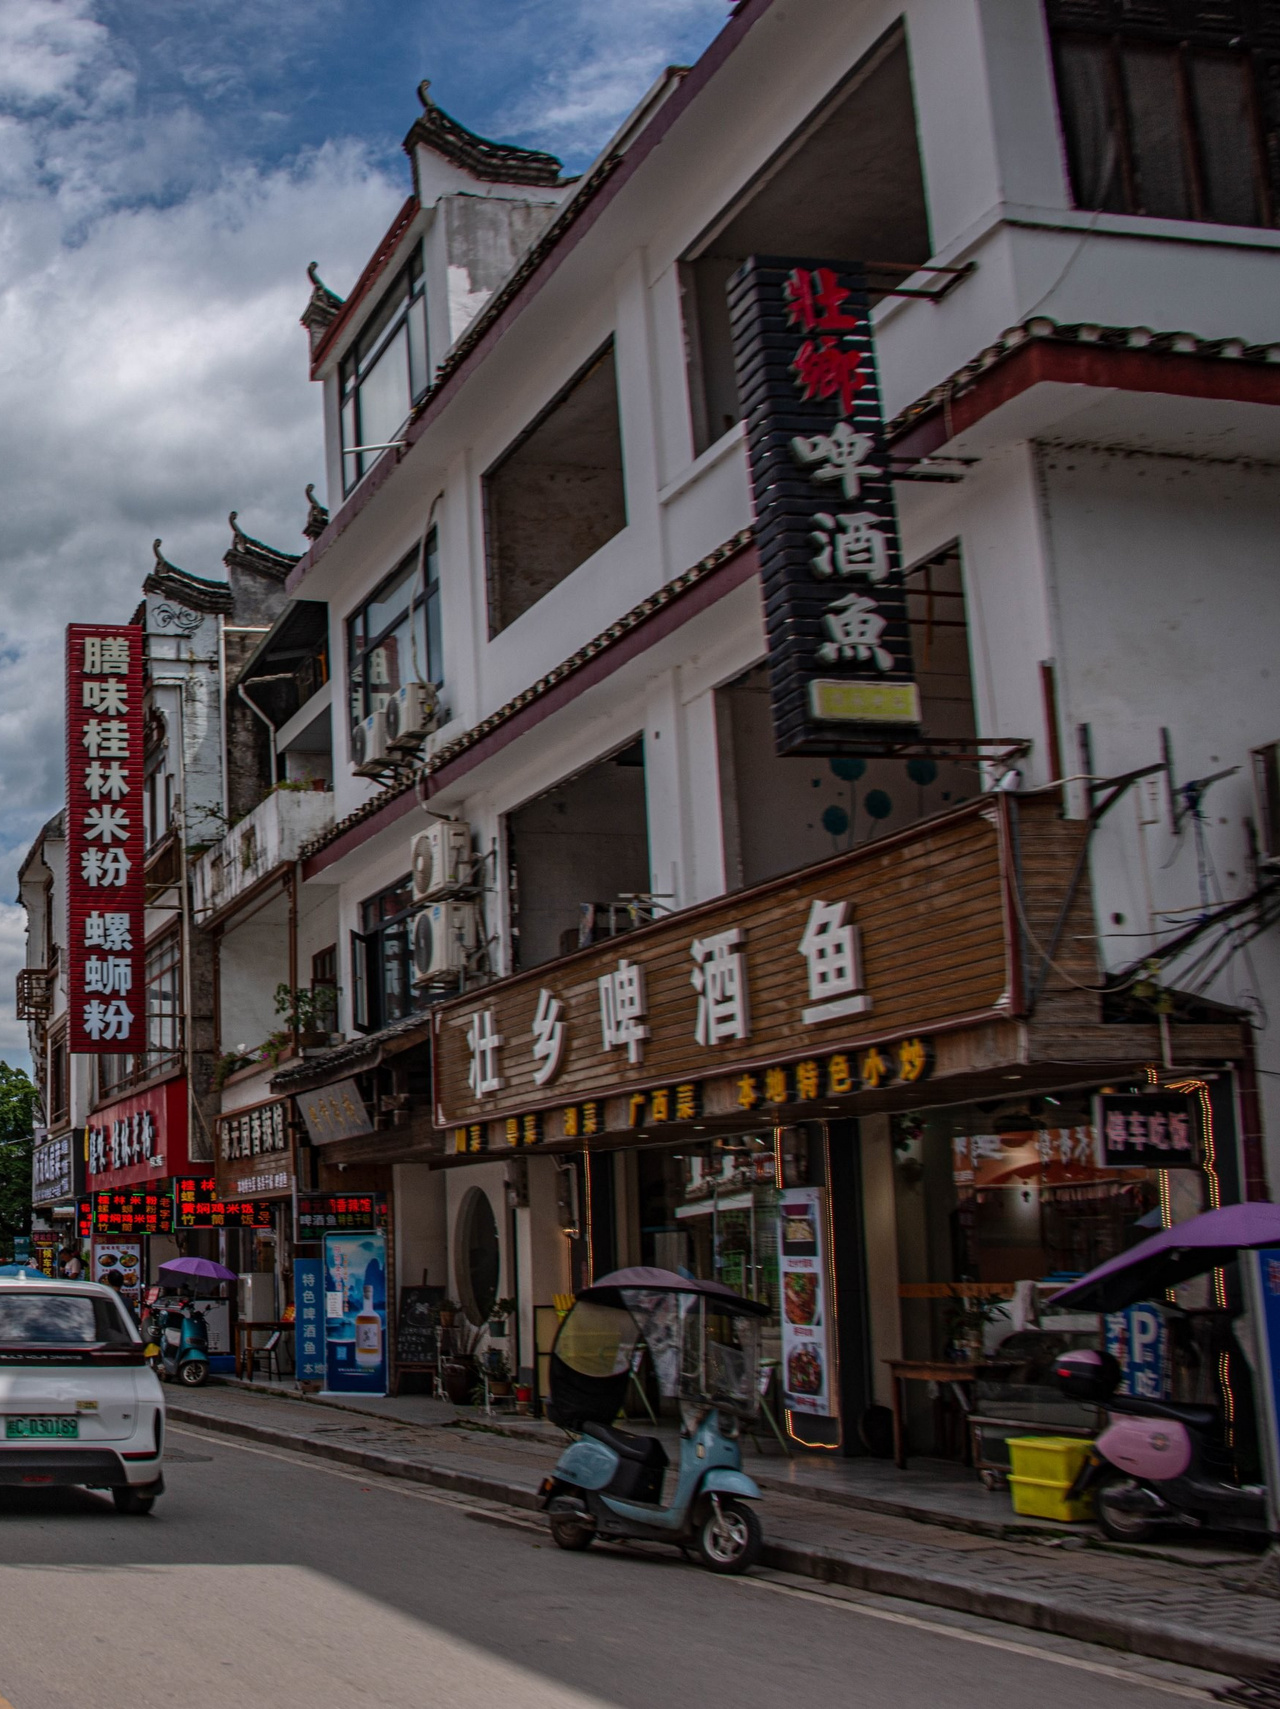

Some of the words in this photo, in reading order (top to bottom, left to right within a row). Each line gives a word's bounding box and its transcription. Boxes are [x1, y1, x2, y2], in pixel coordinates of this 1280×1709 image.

[83, 910, 134, 1041] 螺蛳粉
[467, 899, 873, 1099] 壮乡啤酒鱼
[629, 1084, 696, 1127] 广西菜
[736, 1038, 926, 1112] 本地特色小炒
[181, 1179, 216, 1192] 桂林
[181, 1202, 255, 1215] 黄焖鸡米饭
[302, 1273, 317, 1355] 特色啤酒鱼
[1131, 1311, 1157, 1363] P
